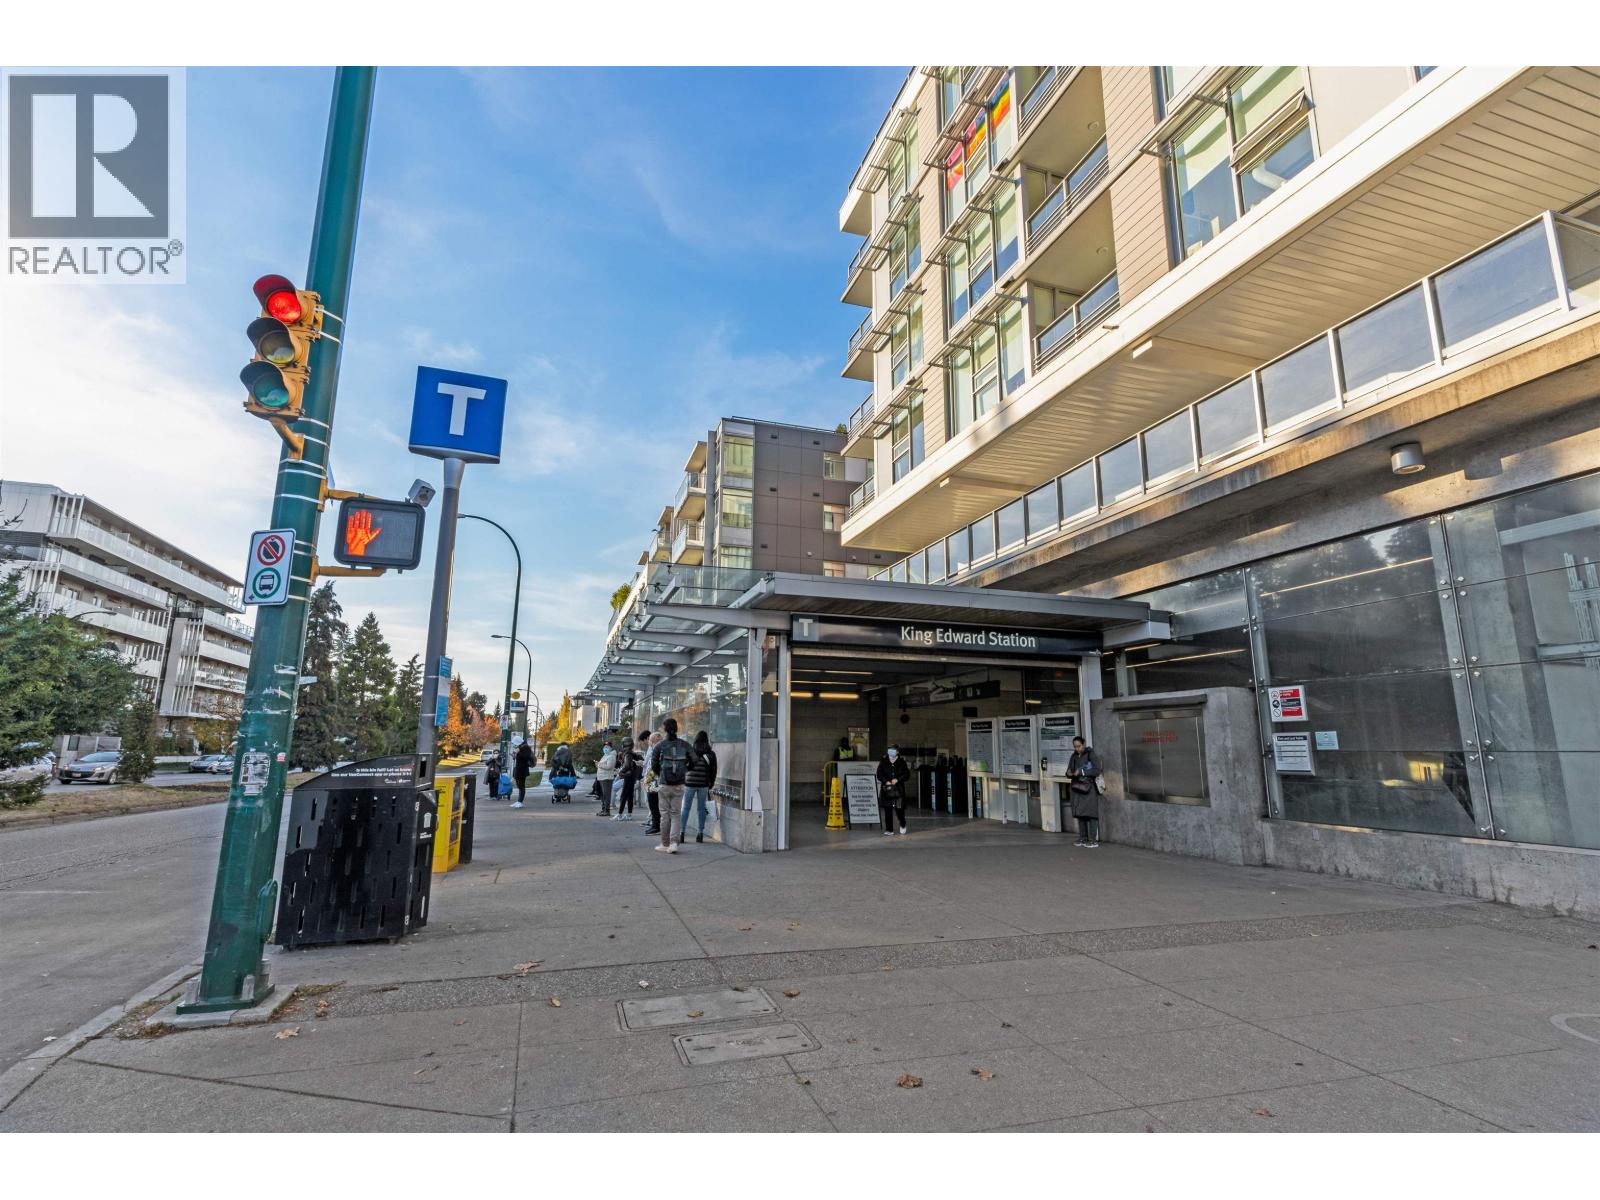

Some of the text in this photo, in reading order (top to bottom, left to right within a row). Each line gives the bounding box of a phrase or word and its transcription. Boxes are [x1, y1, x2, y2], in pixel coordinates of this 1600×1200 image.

[437, 382, 487, 436] T
[799, 618, 1036, 648] T King Edward Station
